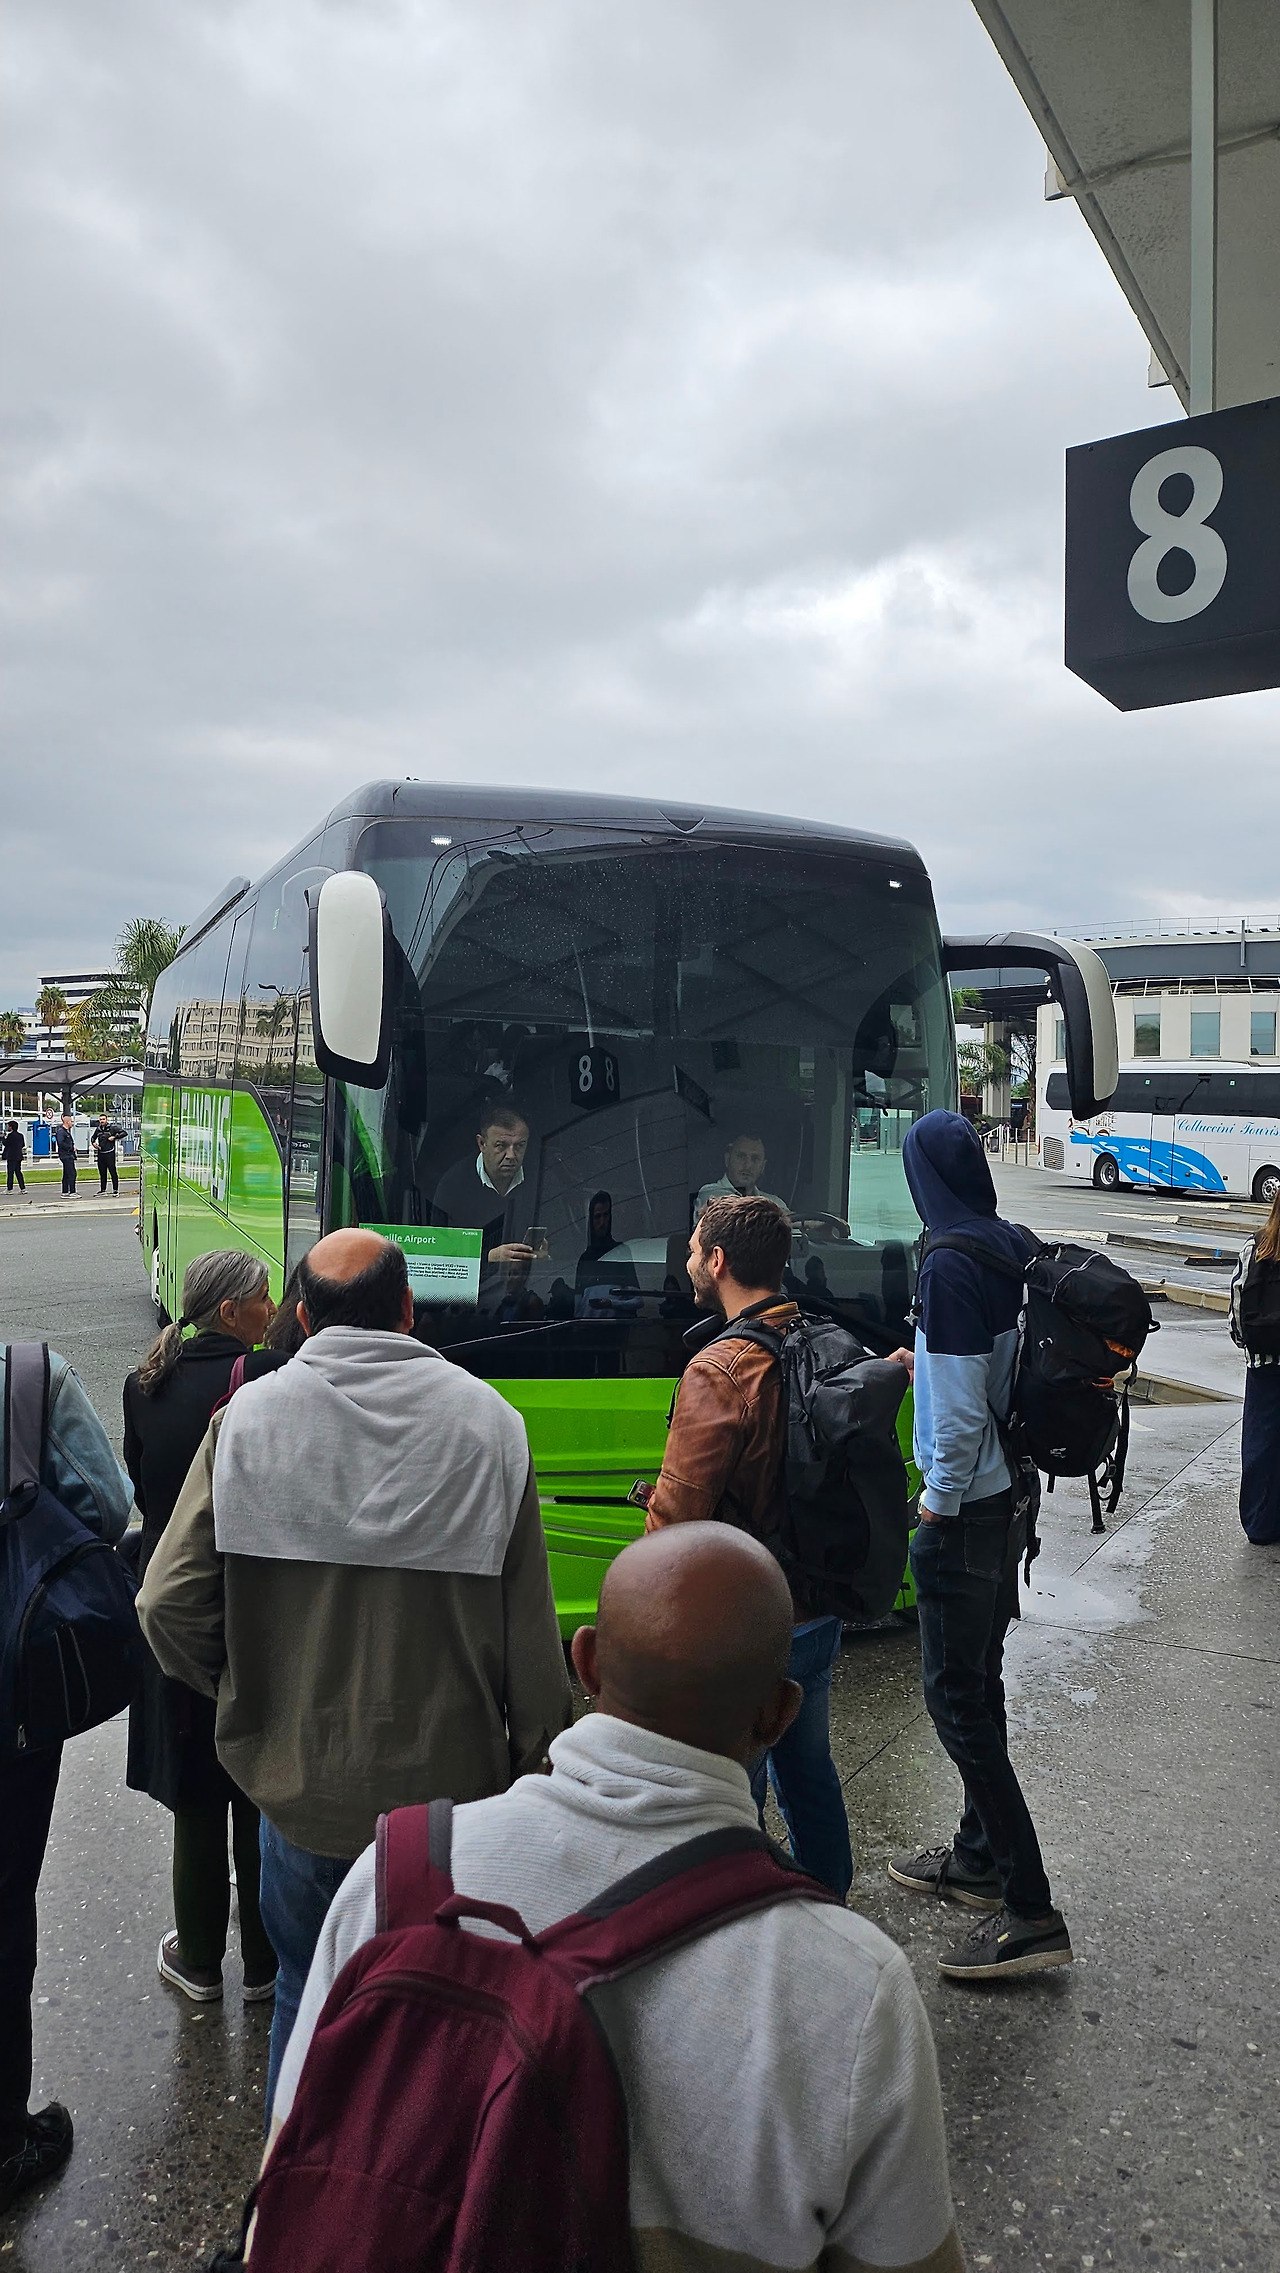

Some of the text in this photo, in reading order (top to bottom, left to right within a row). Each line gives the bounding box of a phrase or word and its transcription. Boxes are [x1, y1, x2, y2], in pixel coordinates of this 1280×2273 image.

[1127, 446, 1228, 623] 8
[1177, 1119, 1236, 1134] Colluccini
[382, 1233, 436, 1244] eille Airport
